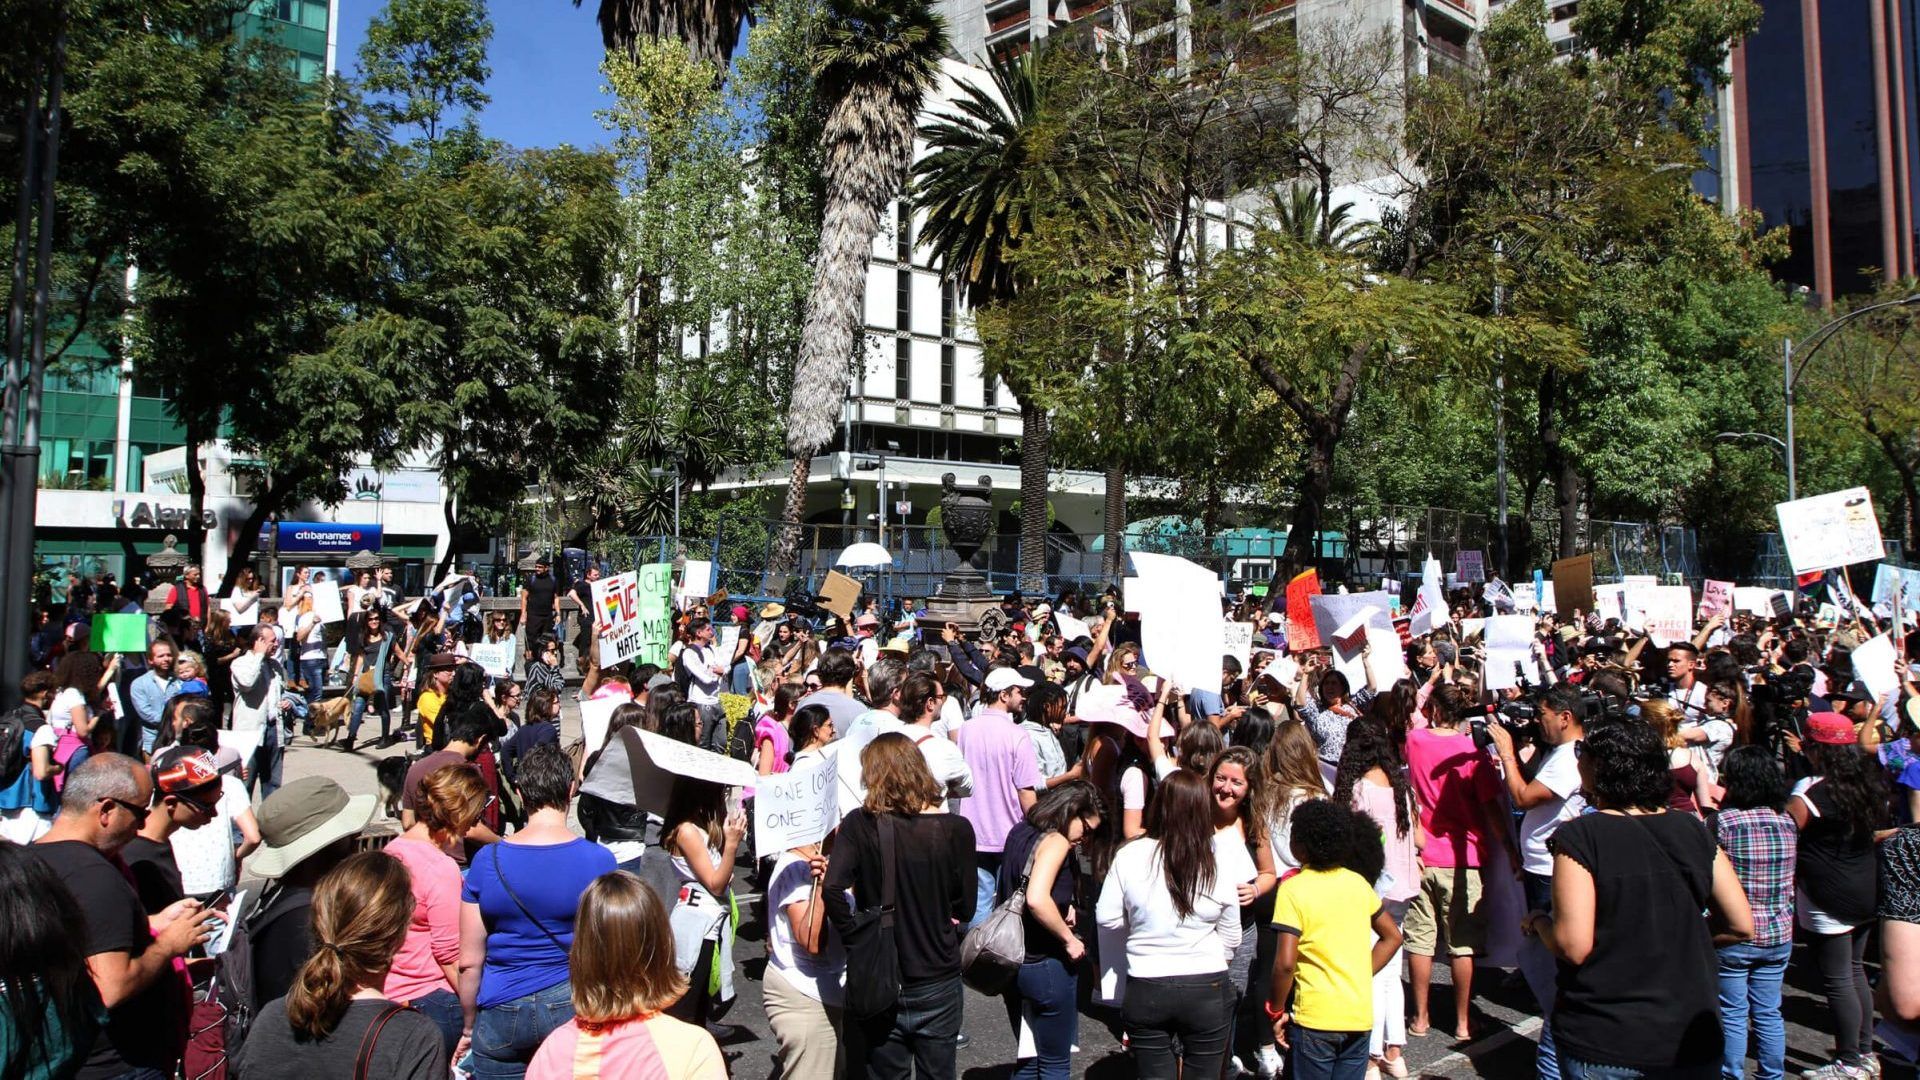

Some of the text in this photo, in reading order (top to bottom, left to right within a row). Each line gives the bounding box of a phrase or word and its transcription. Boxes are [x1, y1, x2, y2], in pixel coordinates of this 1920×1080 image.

[295, 530, 352, 541] citibanamex
[605, 622, 632, 645] TRUMPS
[616, 631, 642, 659] HATE
[774, 781, 804, 801] ONE
[766, 808, 807, 829] ONE
